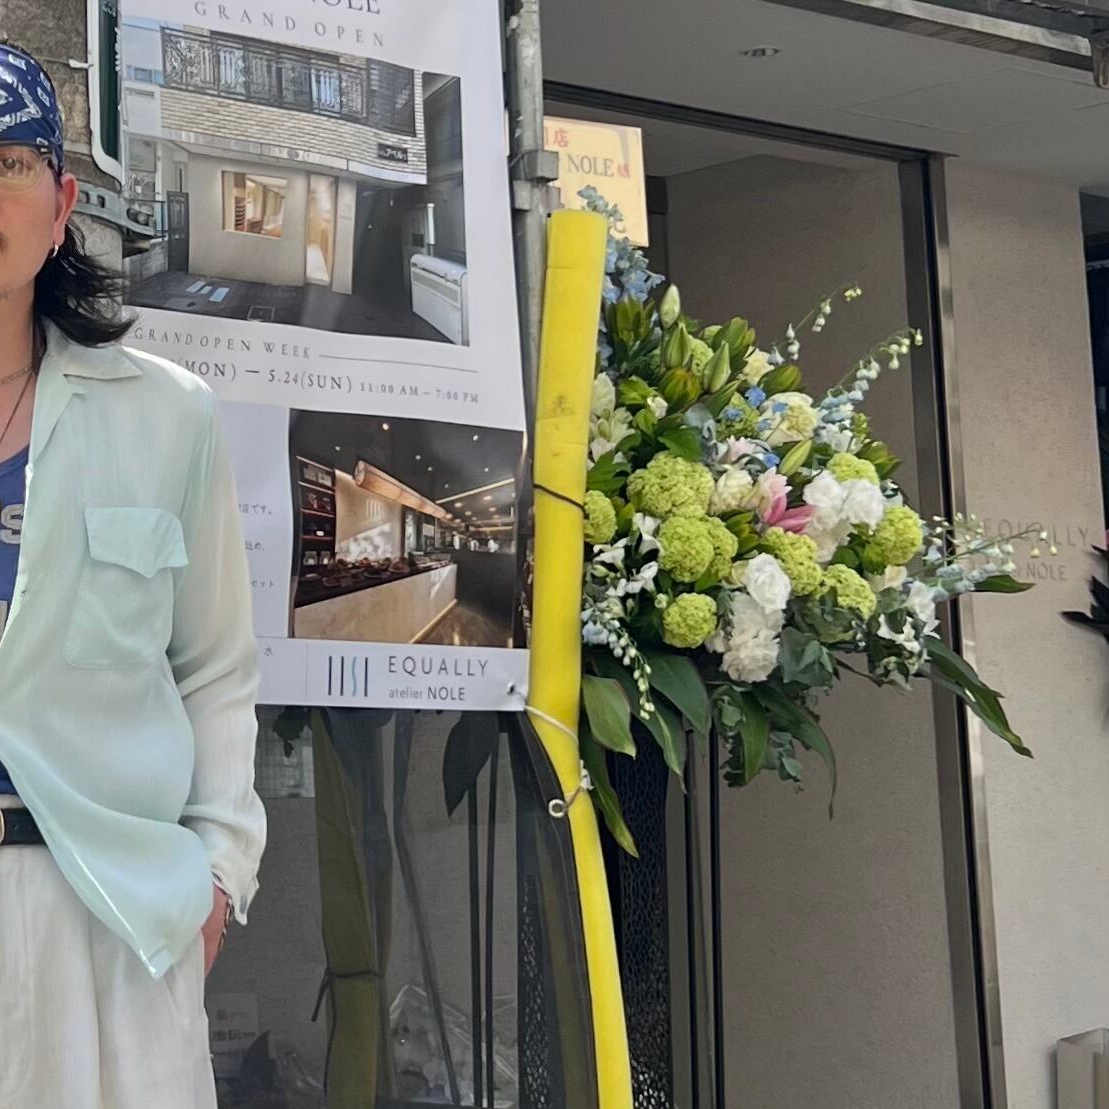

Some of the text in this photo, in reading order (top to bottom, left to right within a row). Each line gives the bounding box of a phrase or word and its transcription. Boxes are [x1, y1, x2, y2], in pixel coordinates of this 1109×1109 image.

[312, 0, 380, 14] LE
[194, 1, 385, 47] GRAND OPEN
[567, 153, 614, 178] NOLE
[134, 326, 311, 359] GRAND OPEN WEEK
[170, 358, 237, 382] (MON)
[267, 368, 352, 393] 5.24(SUN)
[360, 382, 394, 394] 11:00
[400, 385, 418, 397] AM
[463, 392, 479, 403] PM
[1026, 561, 1068, 582] NOLE
[388, 655, 489, 677] EQUALLY
[389, 685, 466, 701] atelier NOLE
